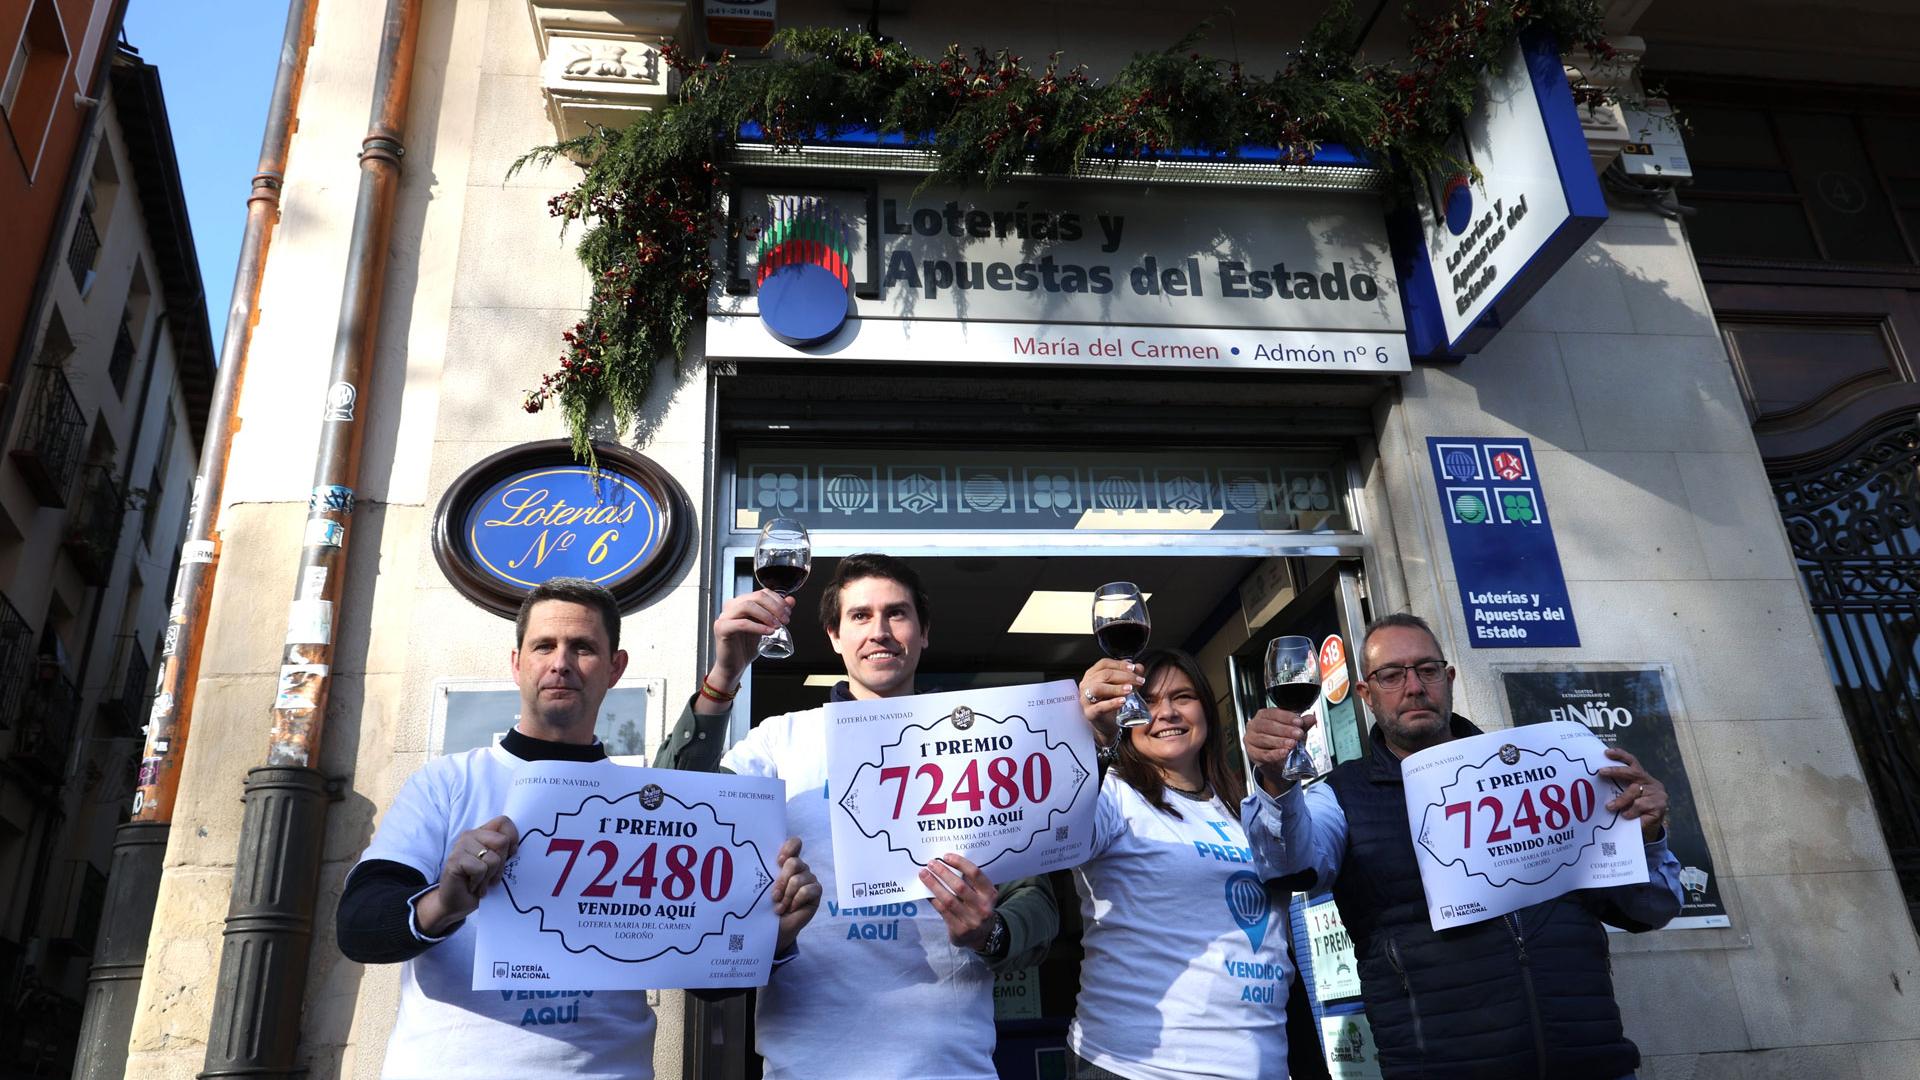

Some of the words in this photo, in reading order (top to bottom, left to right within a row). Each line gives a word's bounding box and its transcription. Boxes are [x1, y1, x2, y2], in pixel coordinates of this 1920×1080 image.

[1493, 199, 1503, 221] y
[884, 201, 1082, 241] Loterías
[1101, 206, 1125, 251] y
[1453, 225, 1506, 294] Apuestas
[1507, 193, 1529, 230] del
[883, 250, 1122, 299] Apuestas
[1130, 257, 1203, 298] del
[1221, 261, 1379, 303] Estado
[1456, 265, 1498, 317] Estado
[1013, 335, 1081, 358] María
[1088, 337, 1124, 358] del
[1130, 339, 1220, 361] Carmen
[1254, 342, 1337, 364] Admón
[1343, 344, 1367, 364] nº
[1375, 346, 1390, 364] 6
[587, 529, 620, 565] 6
[1469, 590, 1528, 604] Loterías
[1531, 593, 1540, 607] y
[1474, 608, 1540, 624] Apuestas
[1542, 607, 1565, 621] del
[1476, 625, 1527, 639] Estado
[1322, 640, 1339, 666] +18
[880, 711, 913, 720] NAVIDAD
[1567, 701, 1633, 731] Niño
[935, 735, 1013, 755] PREMIO
[549, 777, 561, 785] DE
[562, 778, 600, 787] NAVIDAD
[879, 752, 1052, 820] 72480
[1489, 765, 1556, 789] PREMIO
[917, 815, 984, 832] VENDIDO
[988, 806, 1024, 826] AQUÍ
[1445, 778, 1596, 849] 72480
[615, 818, 697, 838] PREMIO
[993, 826, 1021, 836] CARMEN
[956, 841, 990, 850] LOGROÑO
[1487, 837, 1544, 857] VENDIDO
[1547, 826, 1574, 845] AQUÍ
[1193, 841, 1253, 864] PREM
[546, 838, 733, 902] 72480
[869, 880, 897, 890] LOTERÍA
[869, 886, 905, 896] NACIONAL
[577, 901, 651, 916] VENDIDO
[655, 902, 696, 920] AQUÍ
[1455, 902, 1481, 911] LOTERÍA
[1456, 906, 1488, 917] NACIONAL
[615, 931, 654, 940] LOGROÑO
[847, 919, 899, 940] AQUÍ
[1324, 931, 1354, 954] PREM
[511, 964, 543, 972] LOTERÍA
[511, 972, 551, 980] NACIONAL
[1226, 960, 1284, 980] VENDIDO
[993, 986, 1026, 998] EMIO
[1241, 983, 1274, 1003] AQUÍ
[520, 999, 579, 1026] AQUÍ
